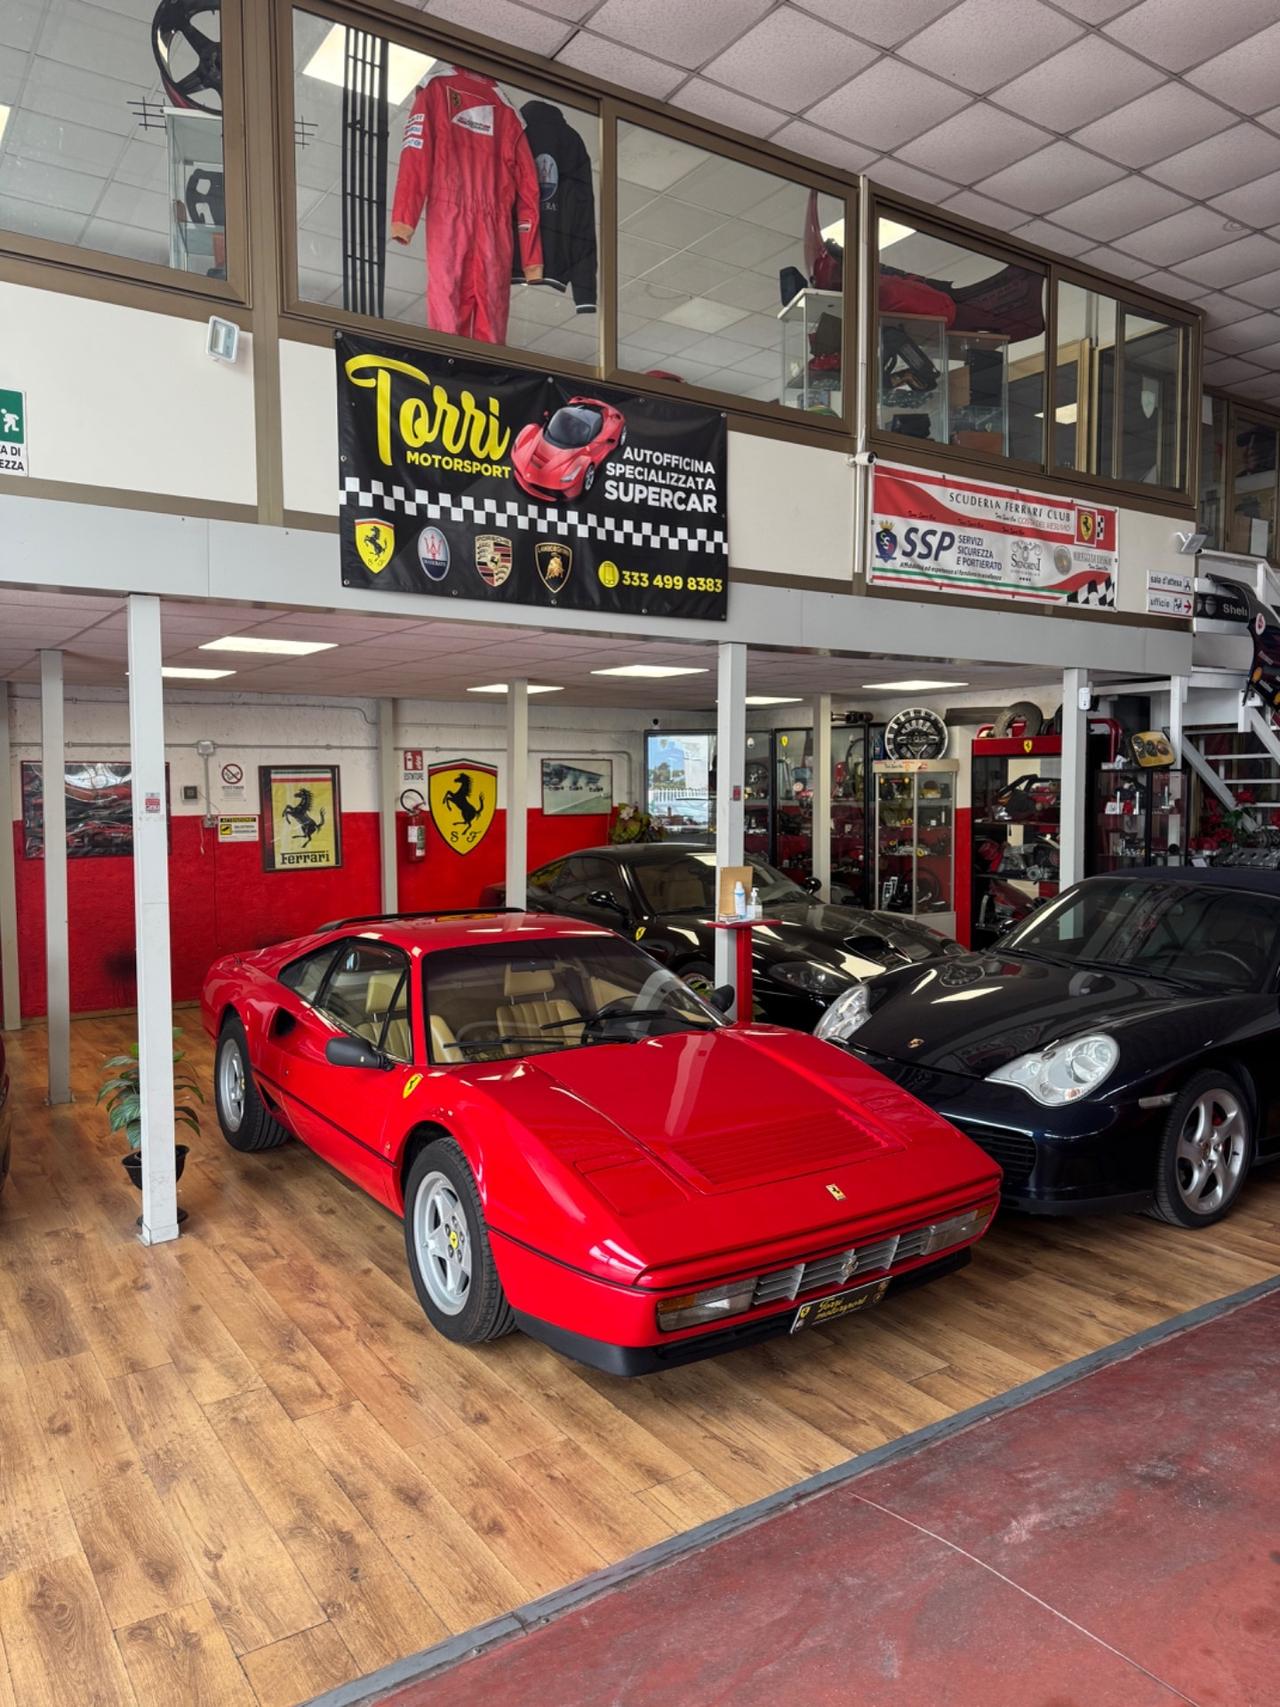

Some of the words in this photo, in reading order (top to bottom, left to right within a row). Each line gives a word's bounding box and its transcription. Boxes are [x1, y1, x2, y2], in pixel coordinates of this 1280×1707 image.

[345, 353, 512, 466] Torri
[10, 446, 21, 457] DI
[406, 450, 511, 479] MOTORSPORT
[622, 446, 716, 474] AUTOFFICINA
[606, 462, 717, 491] SPECIALIZZATA
[604, 480, 718, 513] SUPERCAR
[949, 491, 1001, 510] SCUDERIA
[1004, 501, 1043, 518] FERRARI
[1047, 508, 1071, 522] CLUB
[901, 526, 955, 562] SSP
[957, 546, 994, 559] SICUREZZA
[958, 534, 984, 548] SERVIZI
[956, 556, 962, 566] E
[962, 556, 1003, 572] PORTIERATO
[622, 570, 649, 587] 333
[653, 573, 683, 590] 499
[687, 576, 723, 593] 8383
[280, 850, 330, 865] Ferrari
